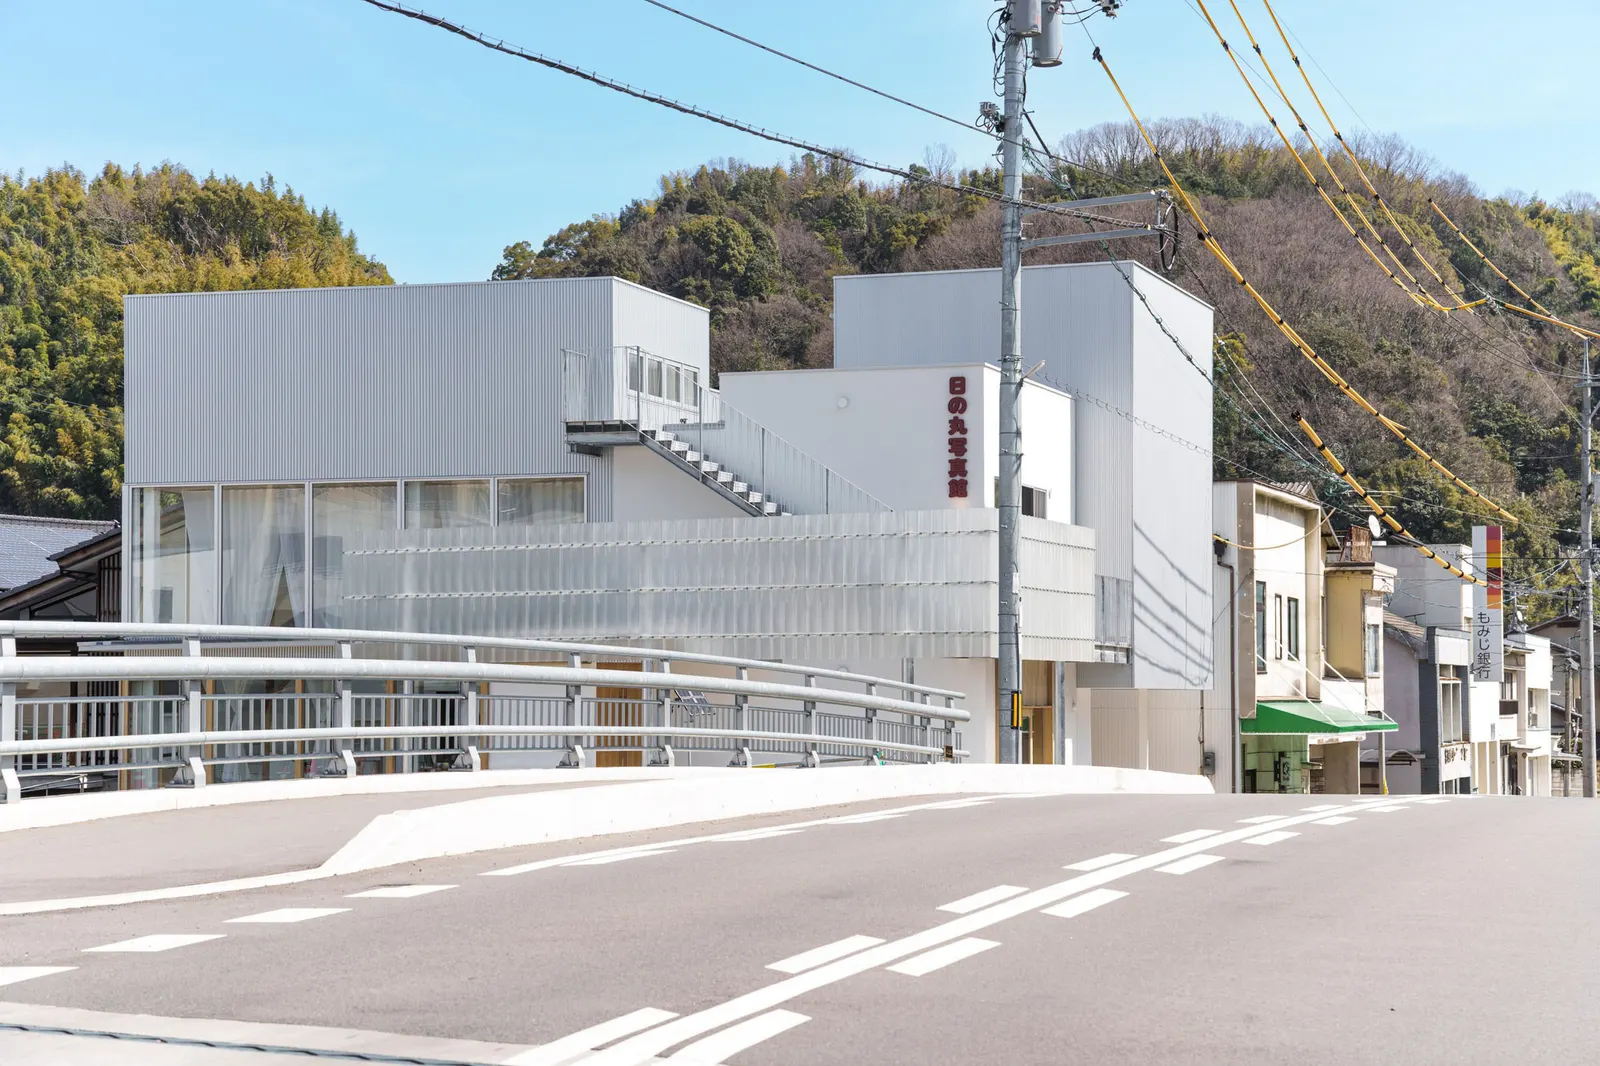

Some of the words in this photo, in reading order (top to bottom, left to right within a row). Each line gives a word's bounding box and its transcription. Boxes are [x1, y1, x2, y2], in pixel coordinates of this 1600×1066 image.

[948, 376, 968, 498] 日の丸写真館
[1477, 611, 1491, 679] もみじ銀行
